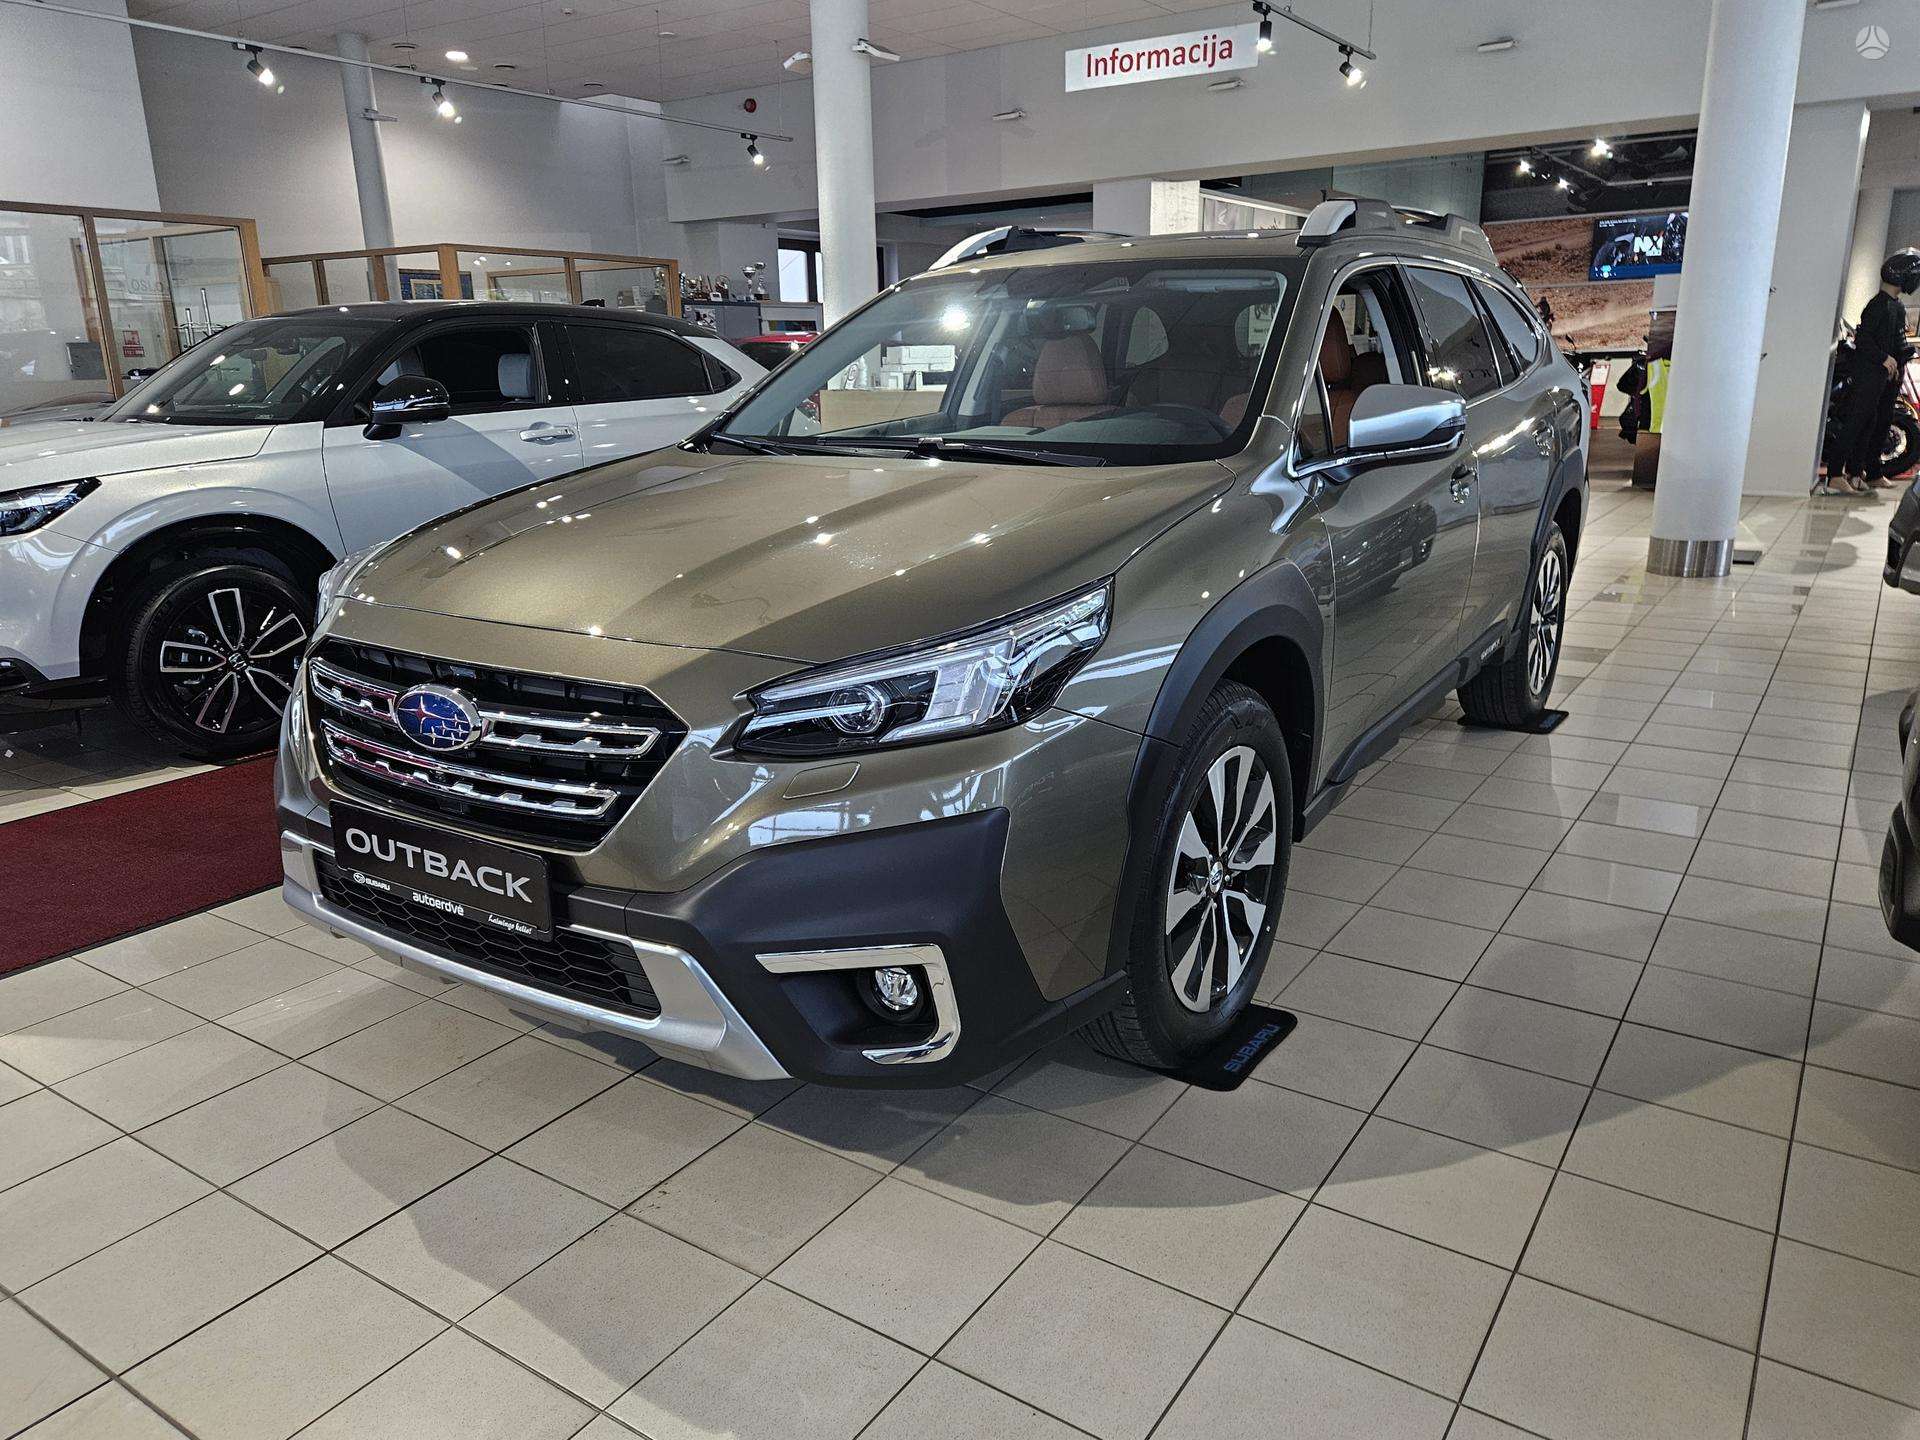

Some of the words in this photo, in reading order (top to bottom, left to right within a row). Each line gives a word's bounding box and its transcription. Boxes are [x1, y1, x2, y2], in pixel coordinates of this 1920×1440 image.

[1087, 34, 1233, 78] Informacija
[345, 827, 533, 903] OUTBACK
[365, 878, 391, 891] SUBARU
[1223, 1023, 1281, 1072] SUBARU
